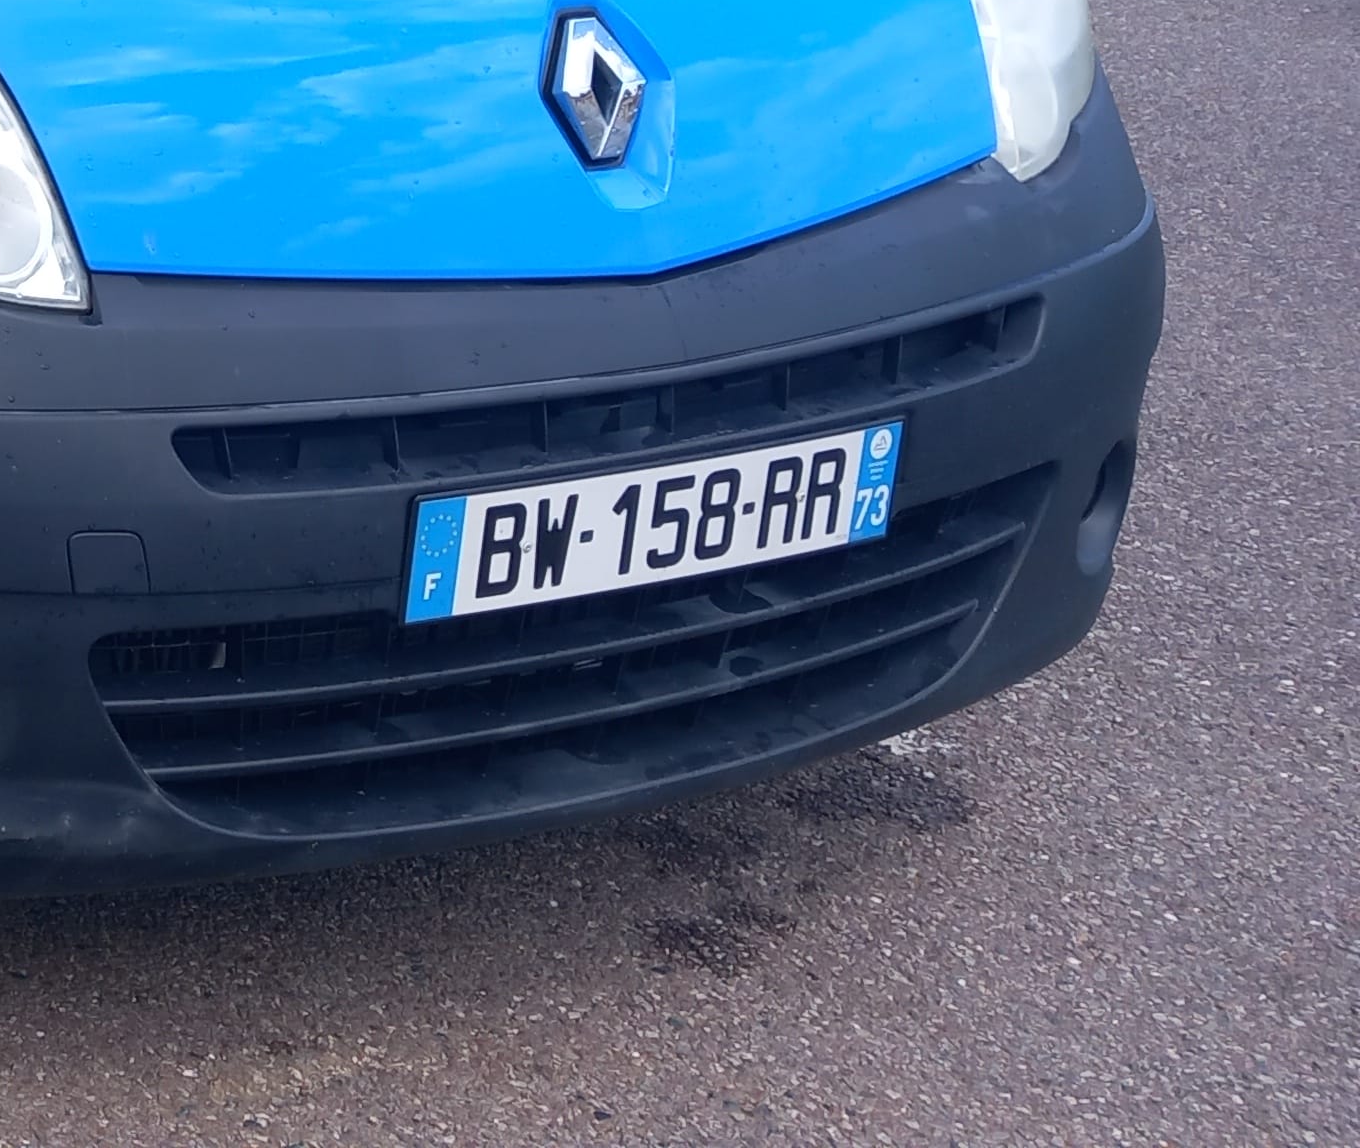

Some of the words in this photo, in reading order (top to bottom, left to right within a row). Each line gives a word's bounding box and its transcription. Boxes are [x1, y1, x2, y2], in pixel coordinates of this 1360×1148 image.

[422, 572, 442, 601] F
[475, 448, 847, 599] BW-158-RR
[854, 483, 891, 532] 73
